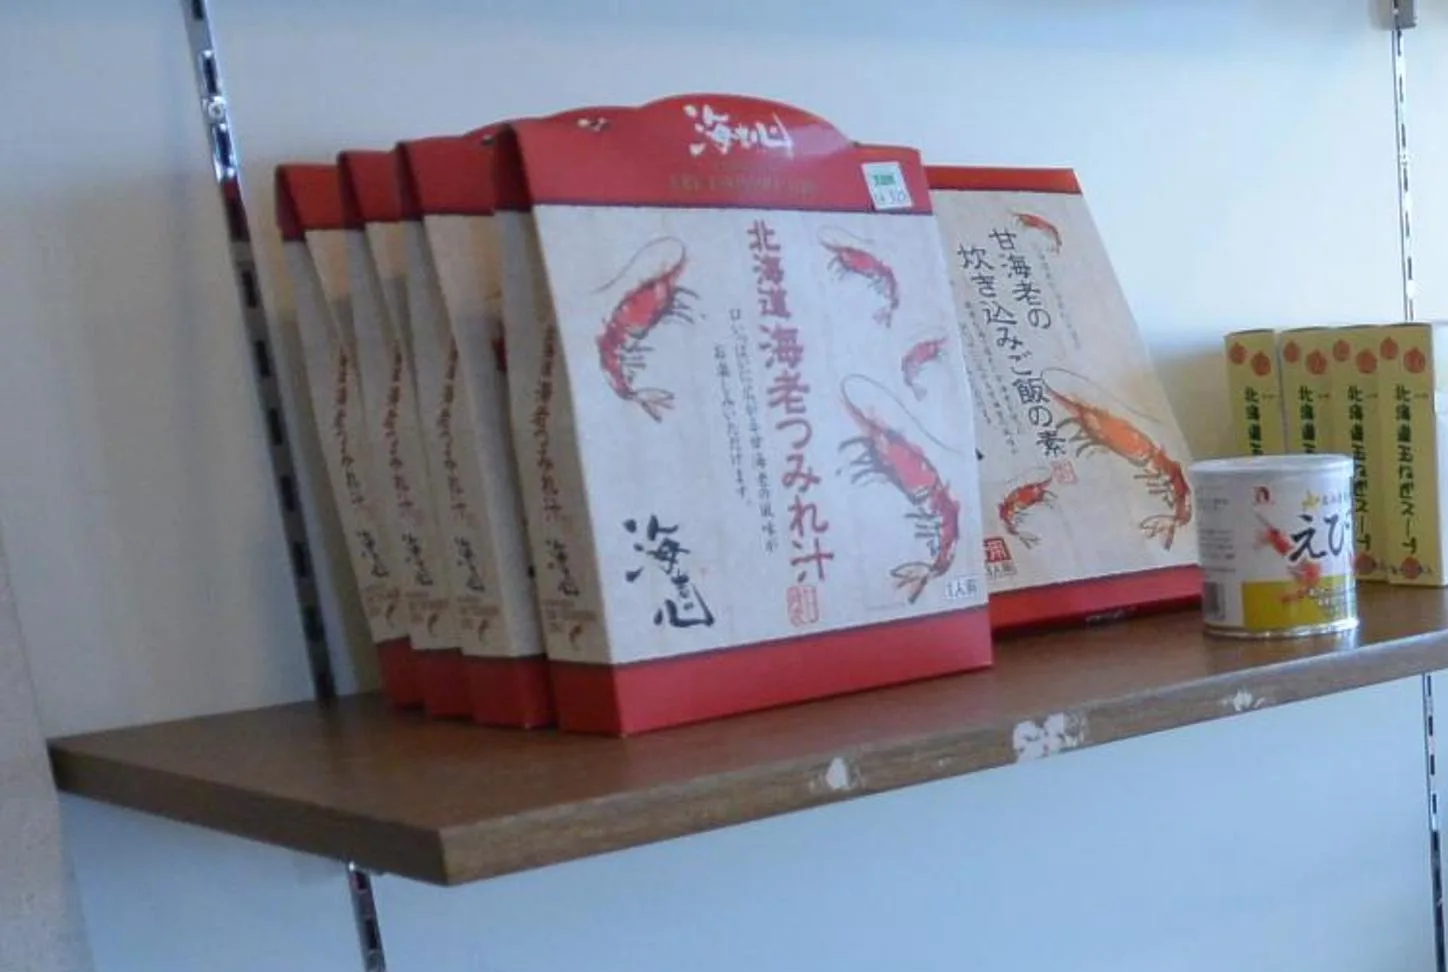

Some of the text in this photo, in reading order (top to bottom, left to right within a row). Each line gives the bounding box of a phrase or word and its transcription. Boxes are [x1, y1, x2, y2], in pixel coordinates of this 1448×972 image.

[956, 243, 1068, 457] 炊き込みご飯の素
[989, 228, 1052, 330] 甘海老の
